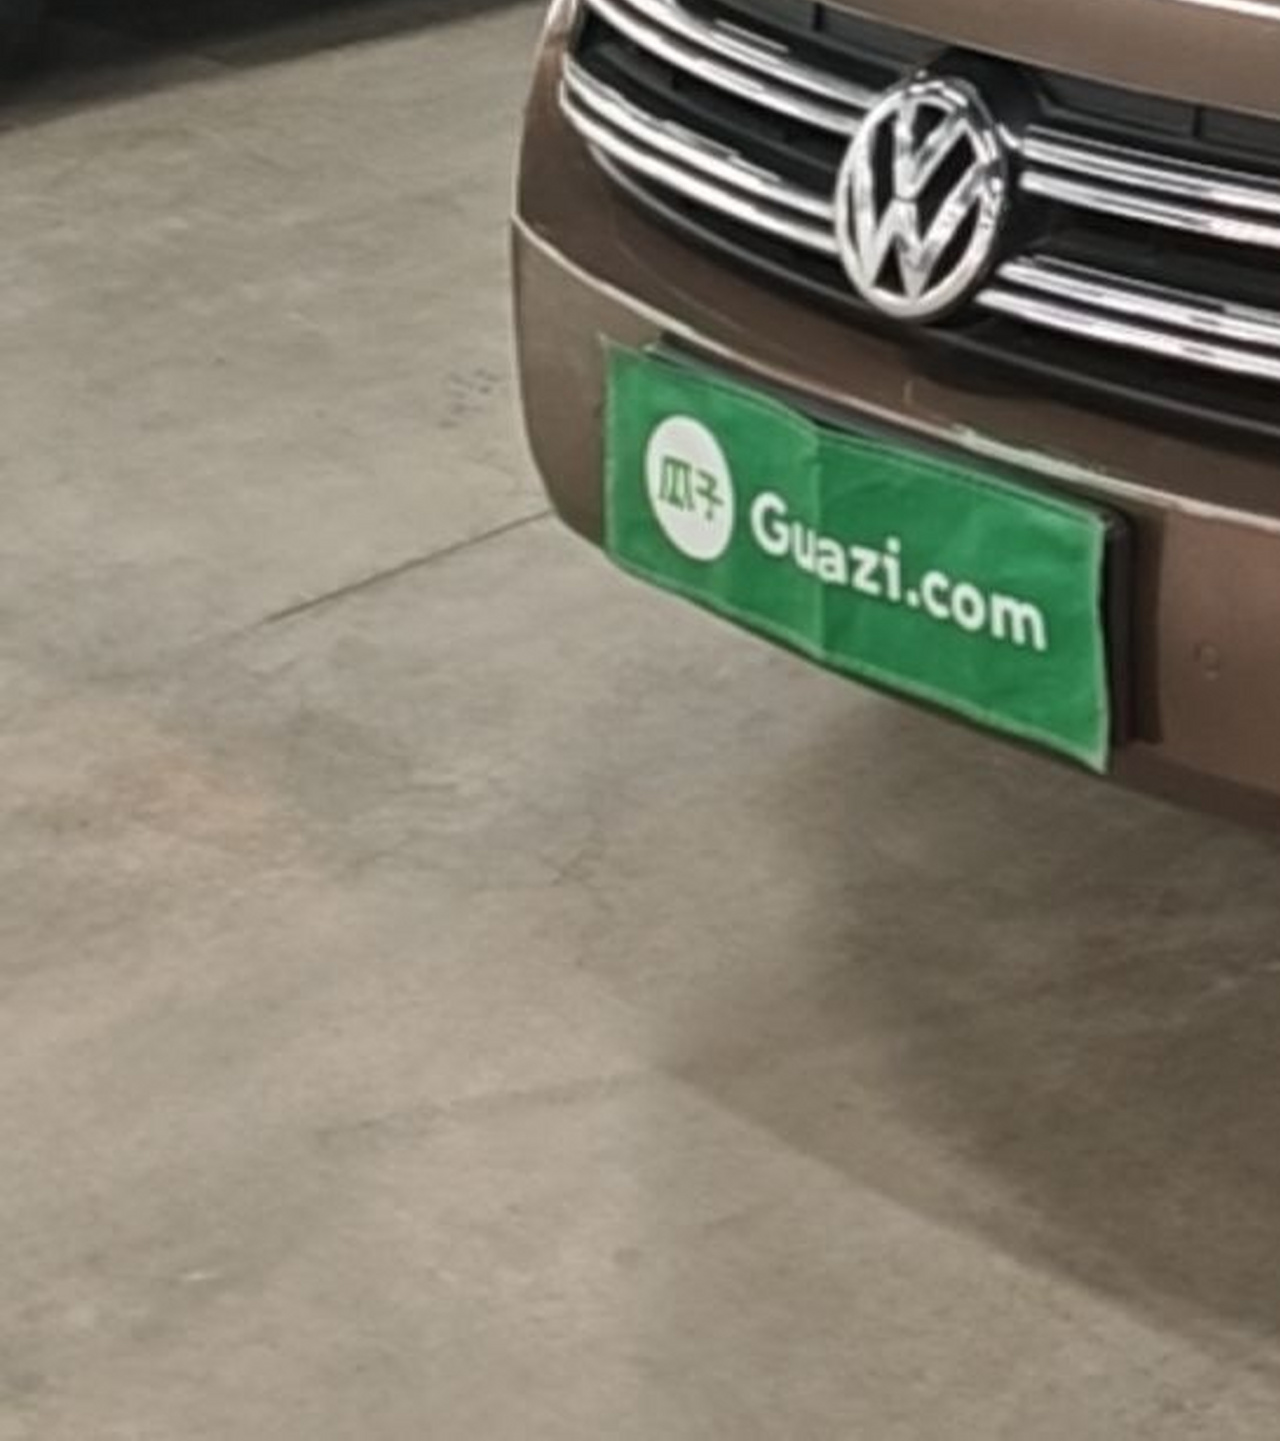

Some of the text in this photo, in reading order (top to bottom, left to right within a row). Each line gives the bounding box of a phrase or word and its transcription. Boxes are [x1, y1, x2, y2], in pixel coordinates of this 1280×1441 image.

[840, 85, 1000, 310] VW
[658, 455, 725, 522] 瓜子
[749, 490, 1048, 652] Guazi.com
